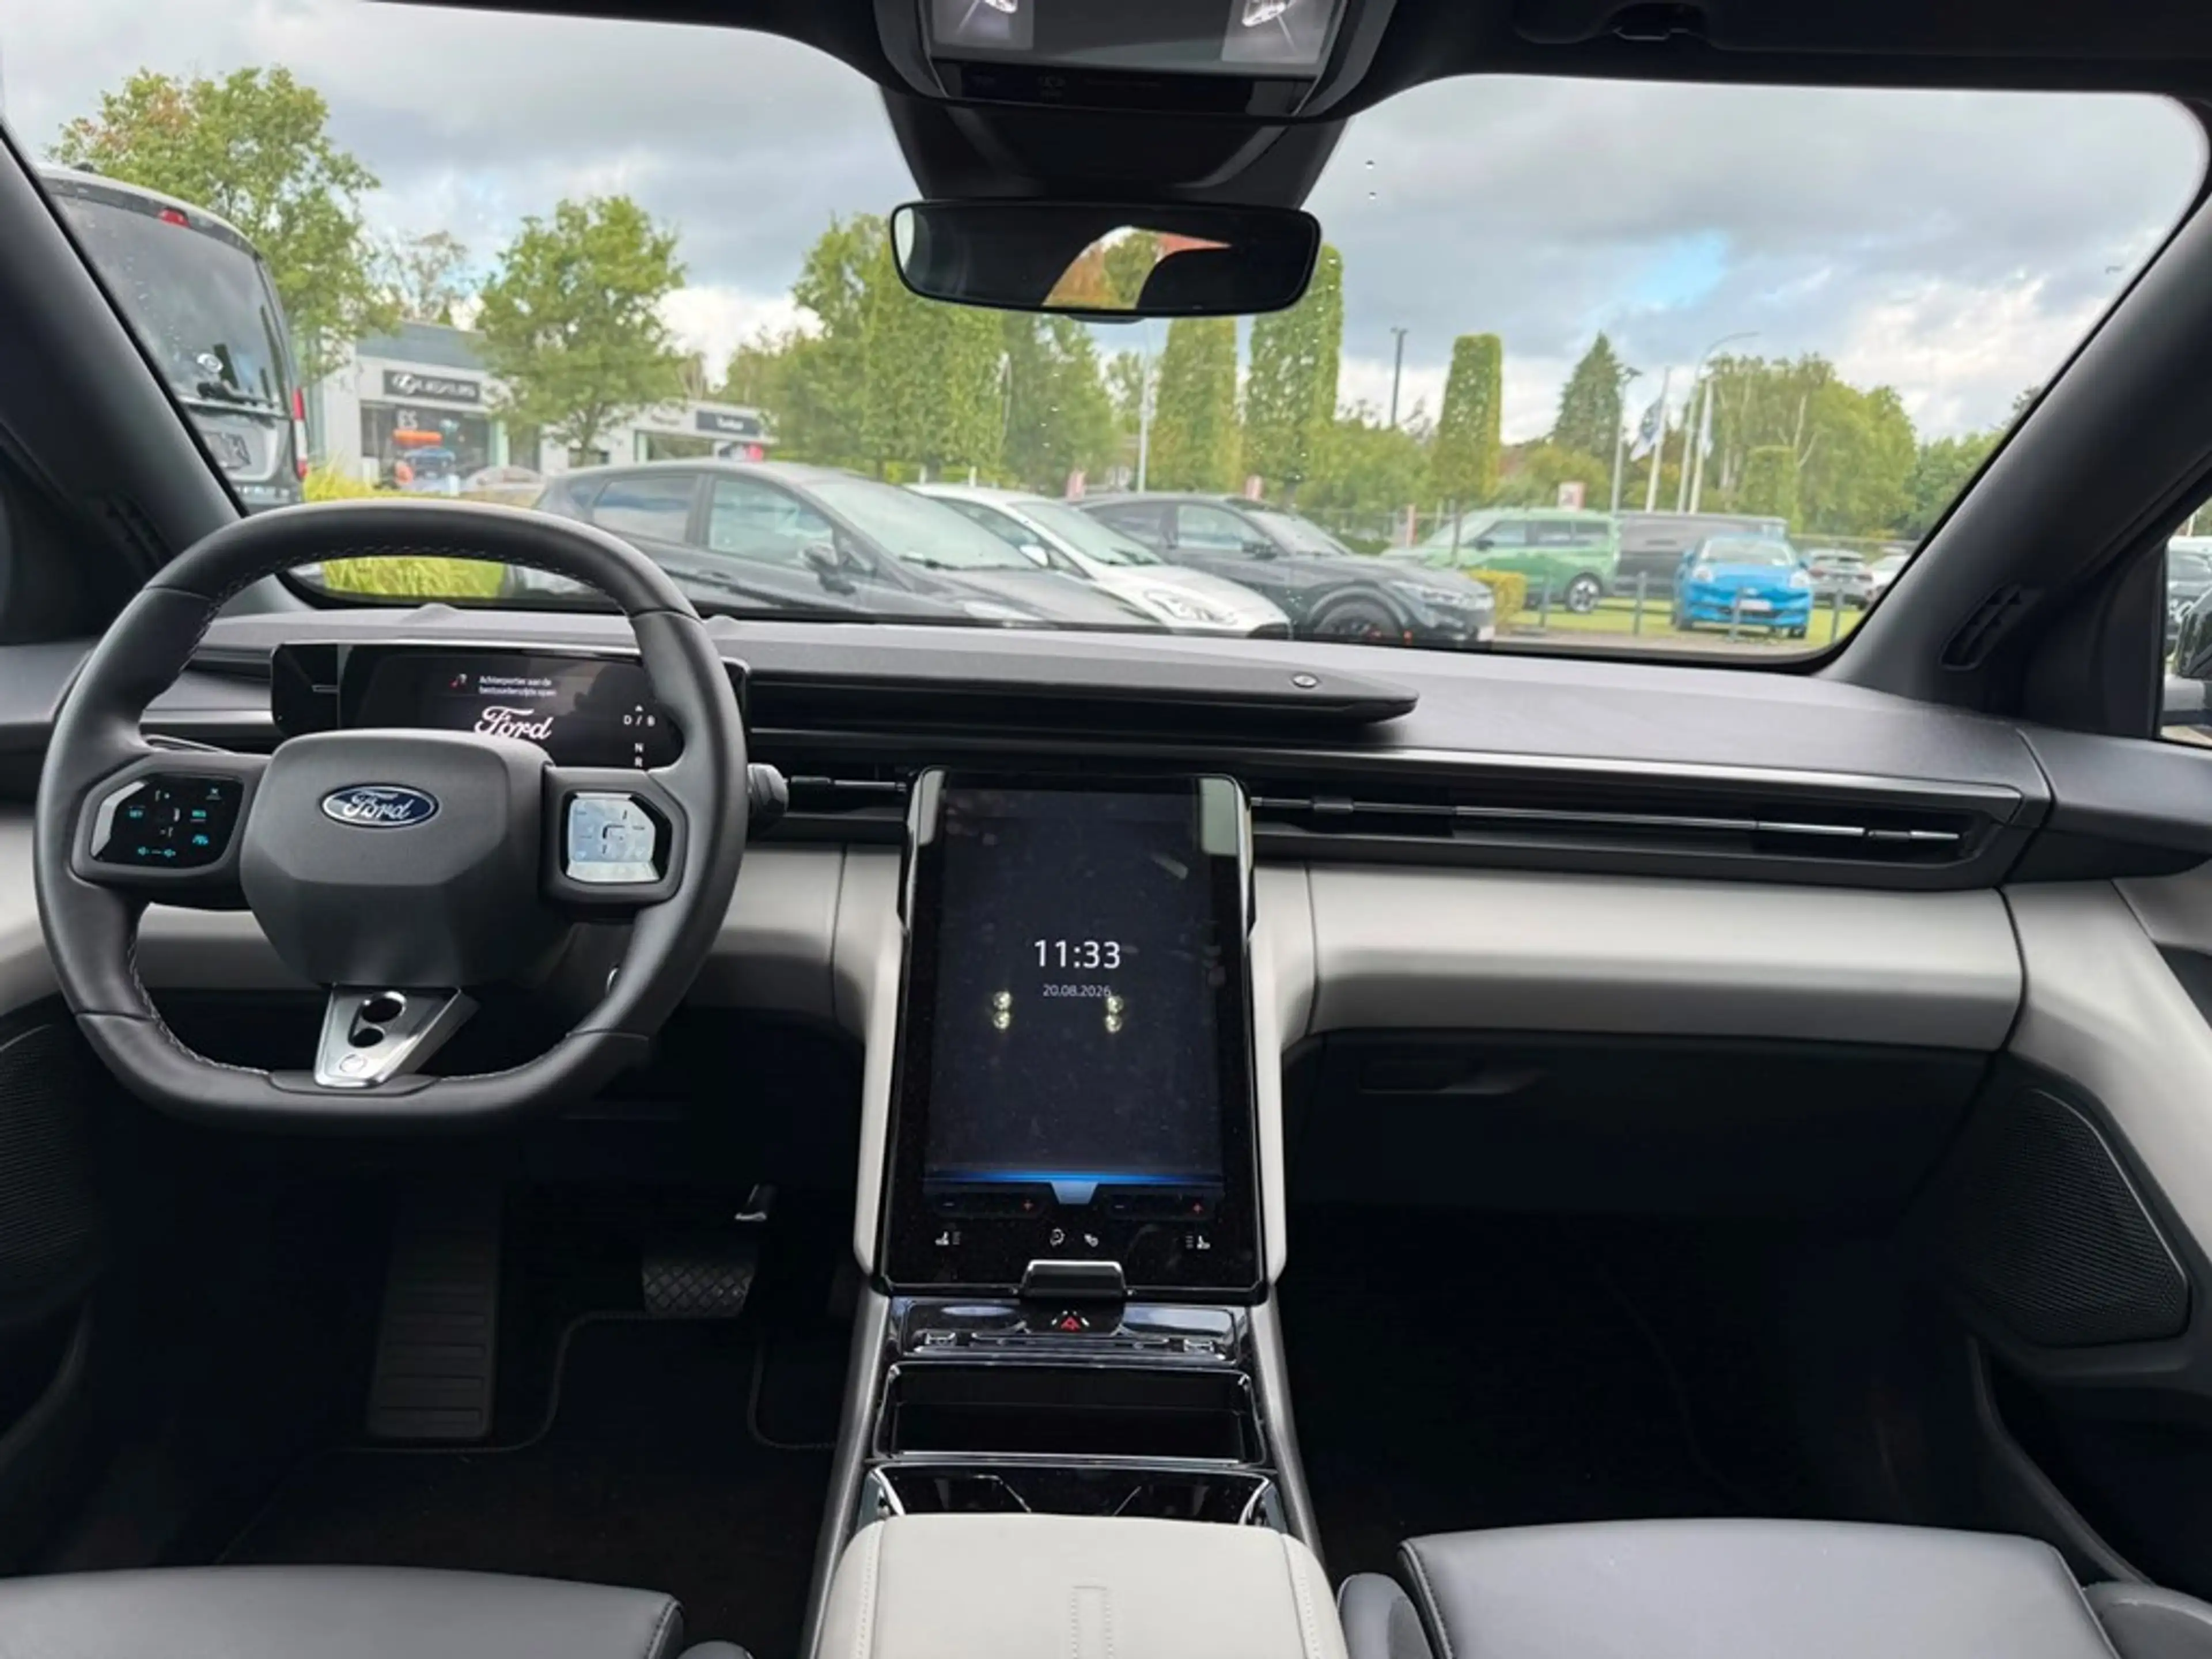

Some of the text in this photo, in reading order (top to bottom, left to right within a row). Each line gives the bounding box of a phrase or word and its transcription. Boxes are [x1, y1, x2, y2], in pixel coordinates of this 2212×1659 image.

[475, 706, 554, 739] Ford
[343, 790, 415, 819] Ford
[1035, 940, 1120, 969] 11:33
[1043, 983, 1111, 997] 20.08.2026
